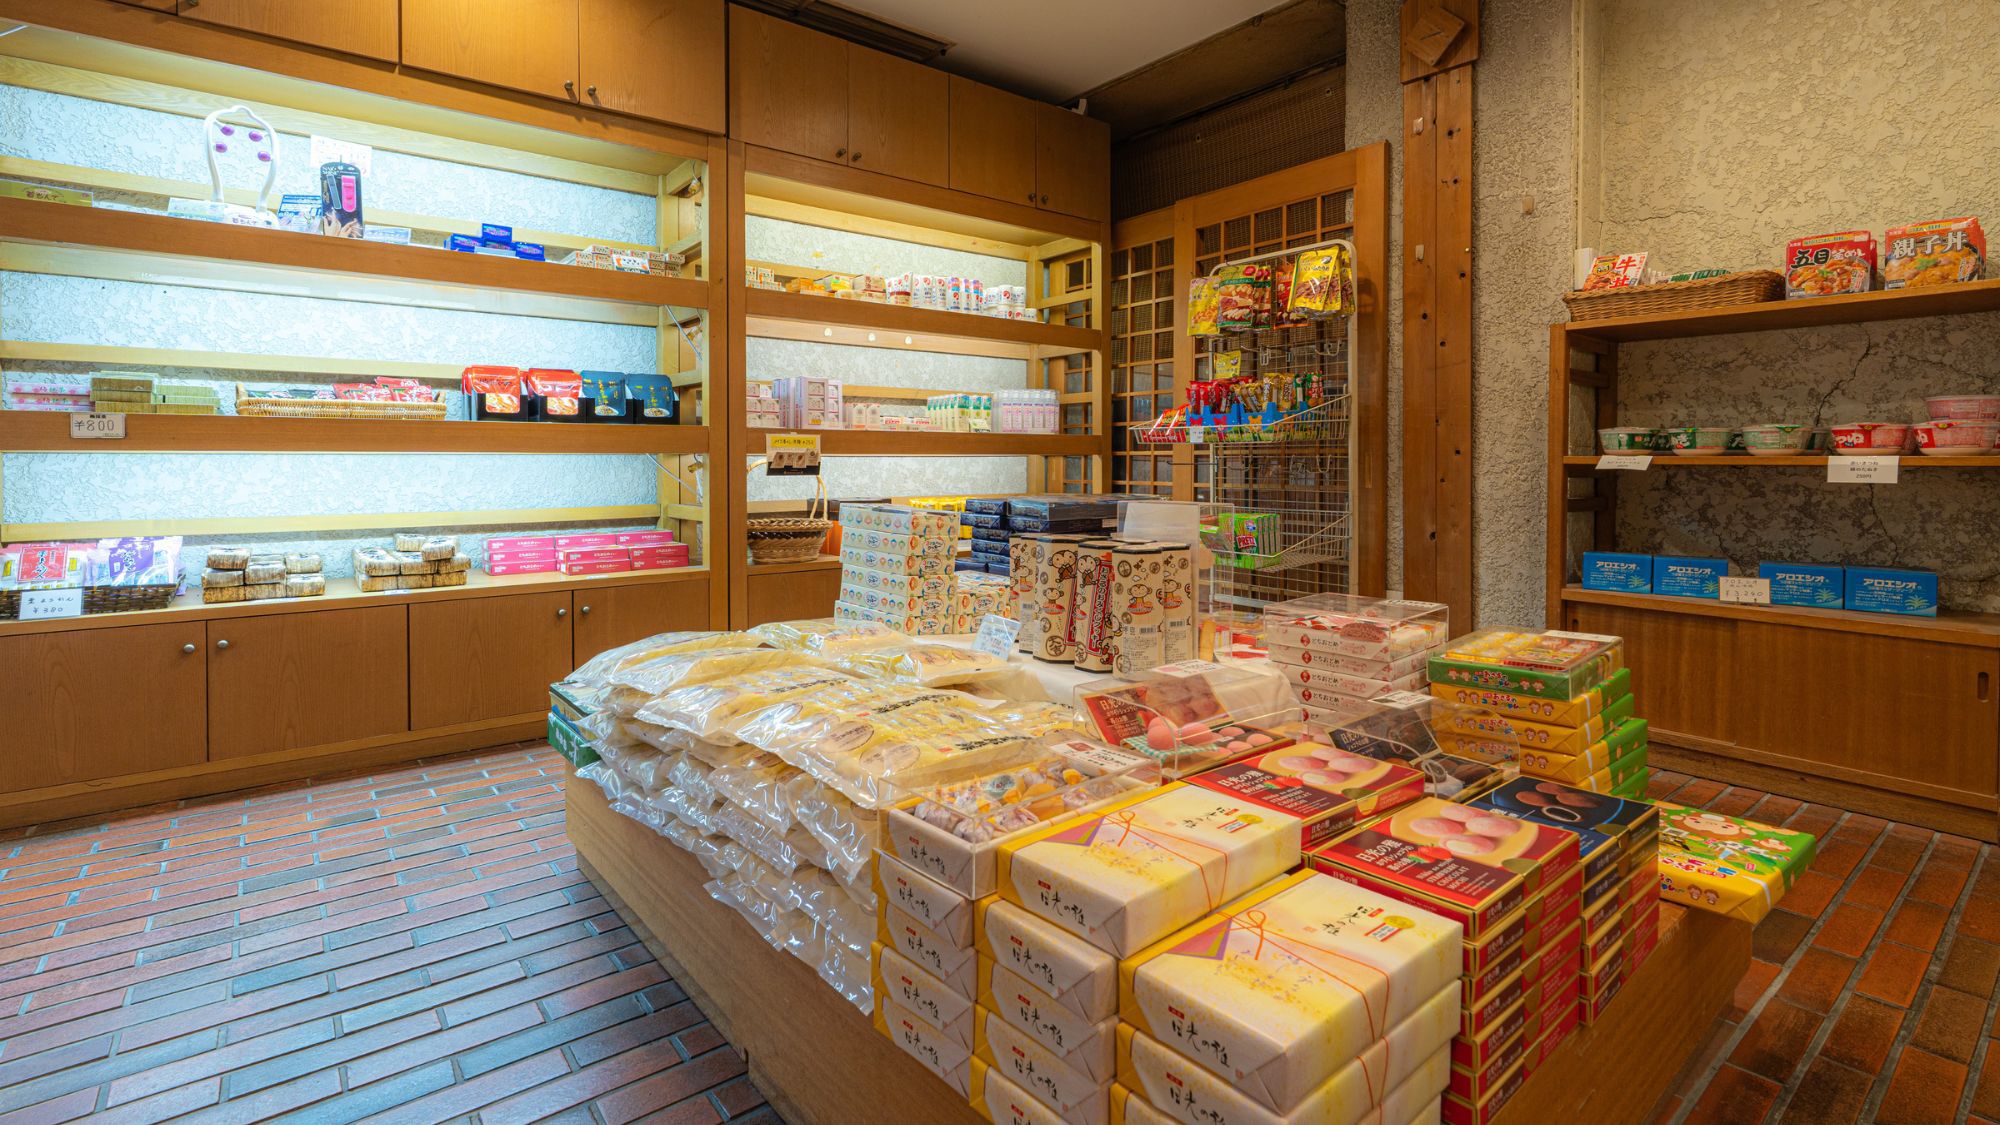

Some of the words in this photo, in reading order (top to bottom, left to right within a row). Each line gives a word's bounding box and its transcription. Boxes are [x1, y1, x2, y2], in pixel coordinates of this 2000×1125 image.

[1893, 231, 1969, 259] 親子丼
[1596, 561, 1637, 570] アロエシオ
[1667, 565, 1712, 575] アロエシオ
[1775, 572, 1825, 583] アロエシオ
[1863, 578, 1919, 589] アロエシオ
[1218, 770, 1264, 787] 日光の雅
[911, 845, 946, 876] 日光の雅
[1355, 839, 1403, 862] 日光の雅
[899, 887, 931, 919] 日光の雅
[1040, 891, 1086, 927] 日光の雅
[908, 936, 942, 970] 日光の雅
[1012, 947, 1055, 986] 日光の雅
[903, 986, 940, 1021] 日光の雅
[1020, 1006, 1064, 1048] 日光の雅
[905, 1030, 940, 1067] 日光の雅
[1172, 1020, 1230, 1068] 日光の雅
[1014, 1058, 1059, 1101] 日光の雅
